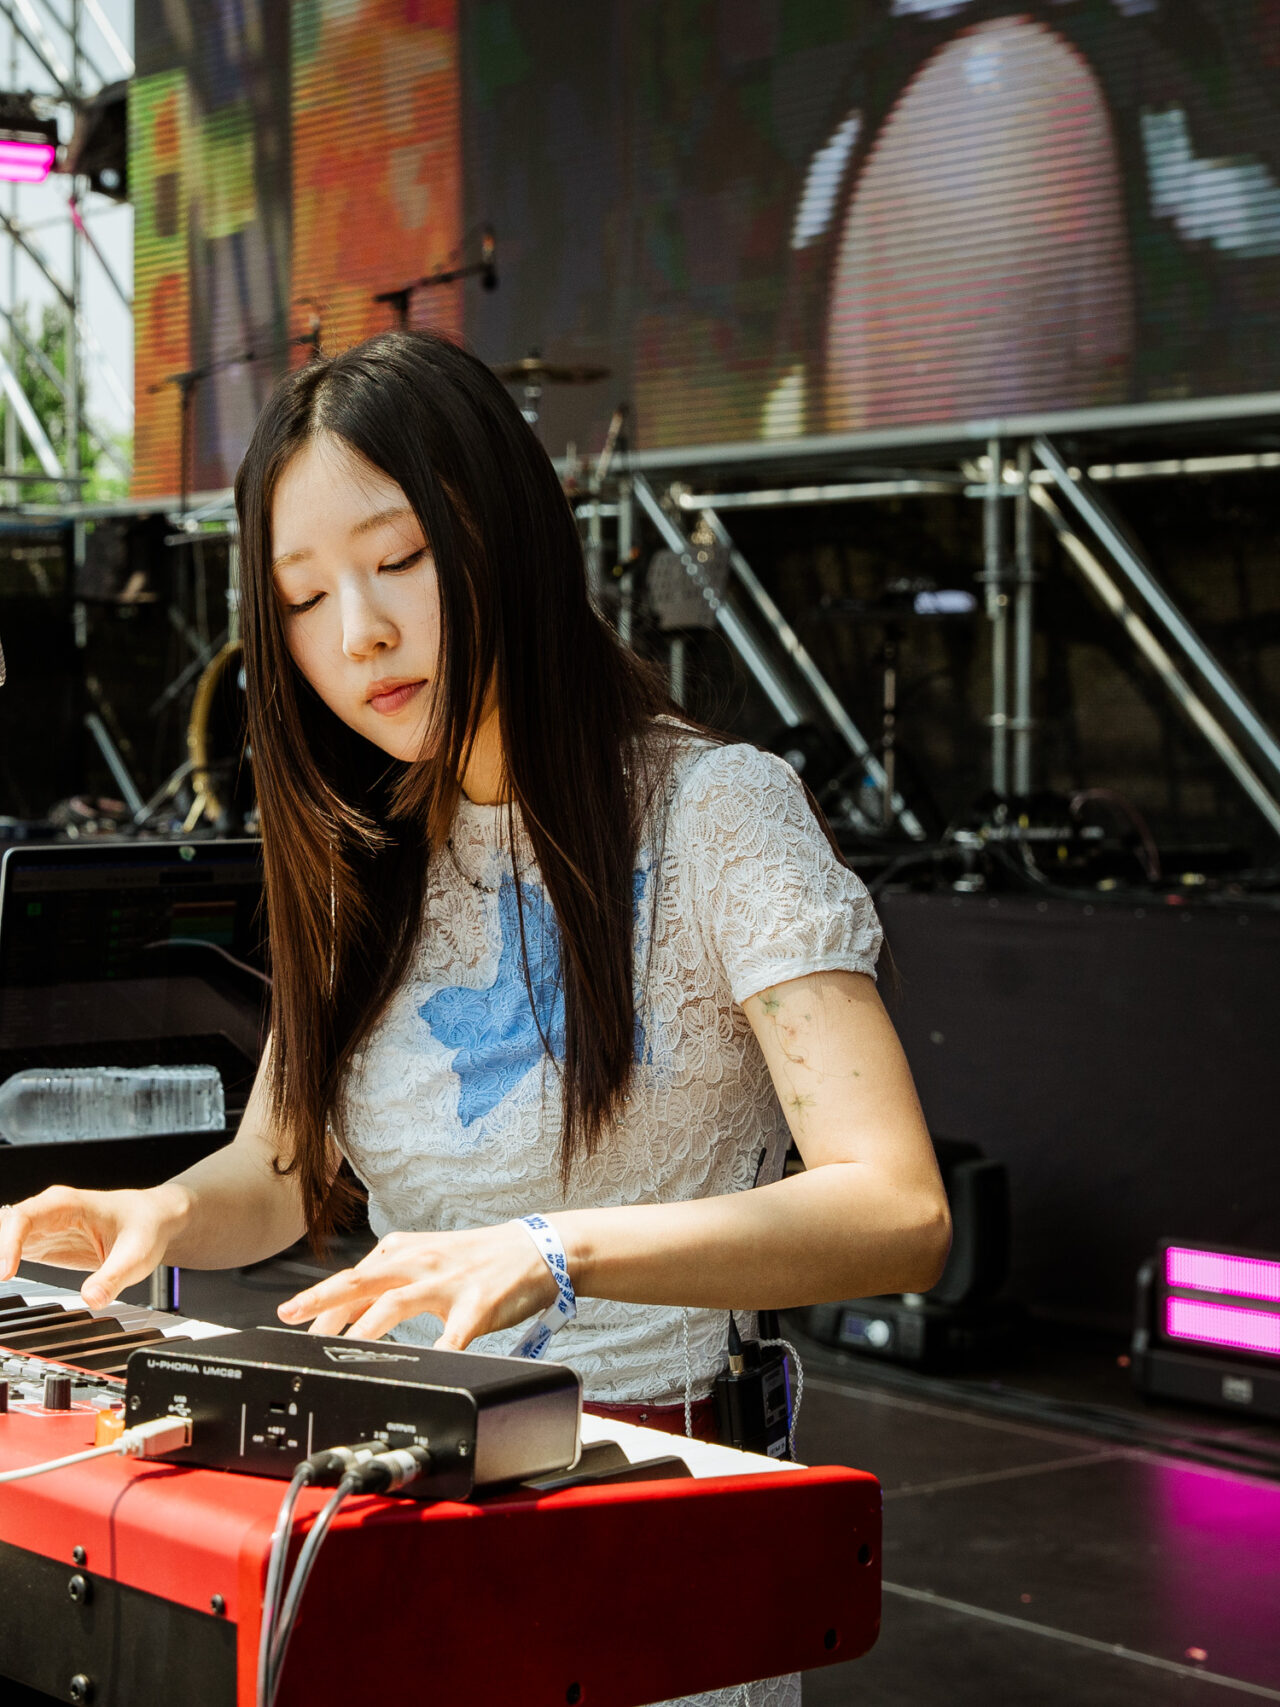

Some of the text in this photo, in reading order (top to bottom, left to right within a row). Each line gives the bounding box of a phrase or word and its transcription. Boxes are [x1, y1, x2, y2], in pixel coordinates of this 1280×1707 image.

[554, 1253, 565, 1271] 202
[147, 1358, 243, 1380] U-PHORIA UMC22
